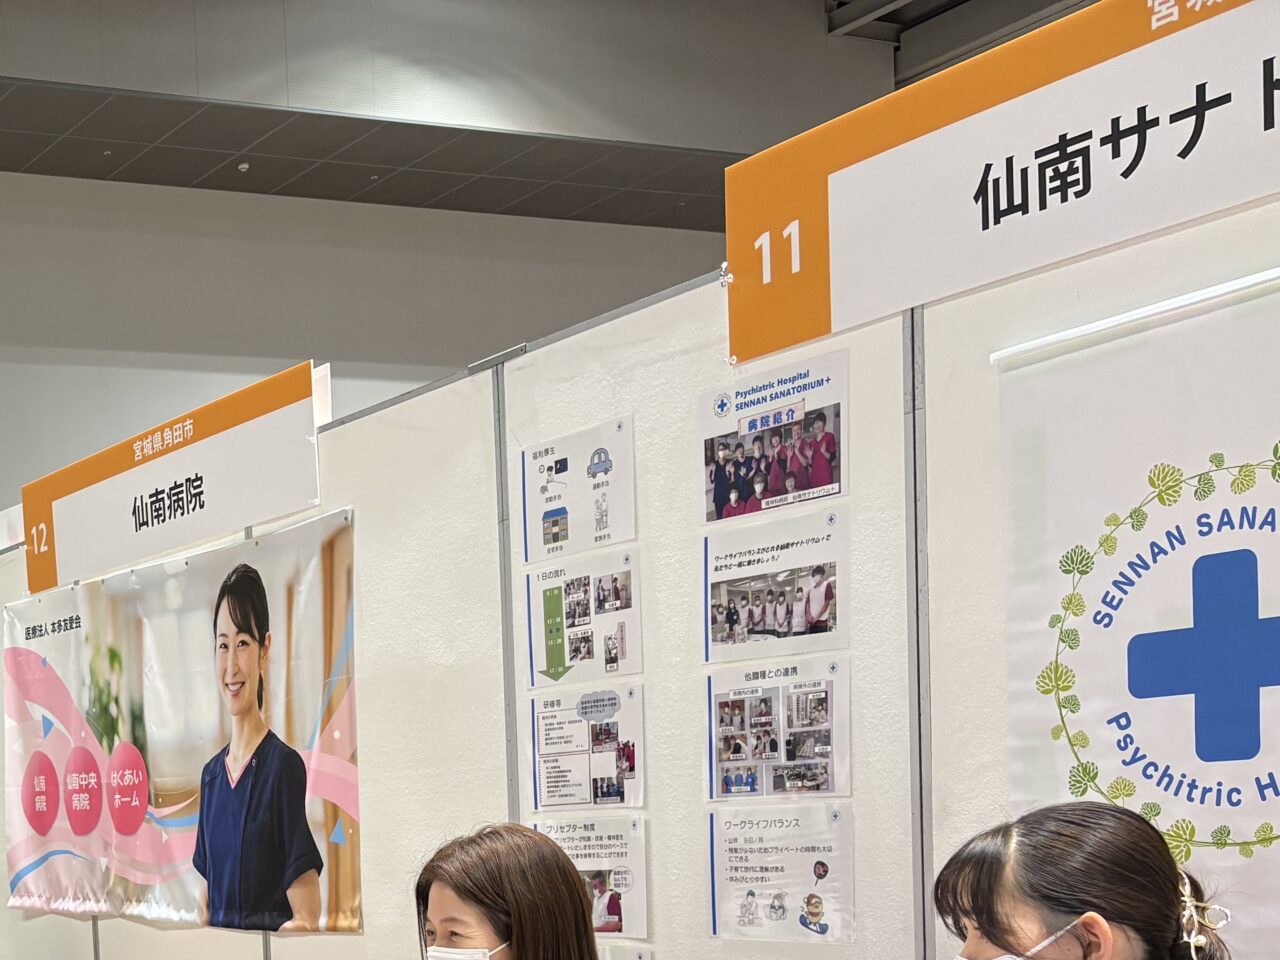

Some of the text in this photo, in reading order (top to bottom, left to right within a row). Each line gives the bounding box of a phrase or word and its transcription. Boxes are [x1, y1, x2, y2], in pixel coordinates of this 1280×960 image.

[753, 219, 801, 285] 11
[735, 369, 810, 400] Psychiatric Hospital
[735, 397, 768, 412] SENNAN
[747, 408, 796, 432] 病院紹介
[132, 418, 195, 461] 宮城県角田市
[131, 473, 205, 533] 仙南病院
[30, 522, 48, 555] 12
[1092, 506, 1276, 629] SENNAN SANA
[24, 621, 49, 640] 医療法人
[1106, 711, 1242, 807] Psychitric
[110, 769, 143, 787] はくあい
[113, 791, 140, 809] ホーム
[724, 818, 800, 830] ワークライフバランス
